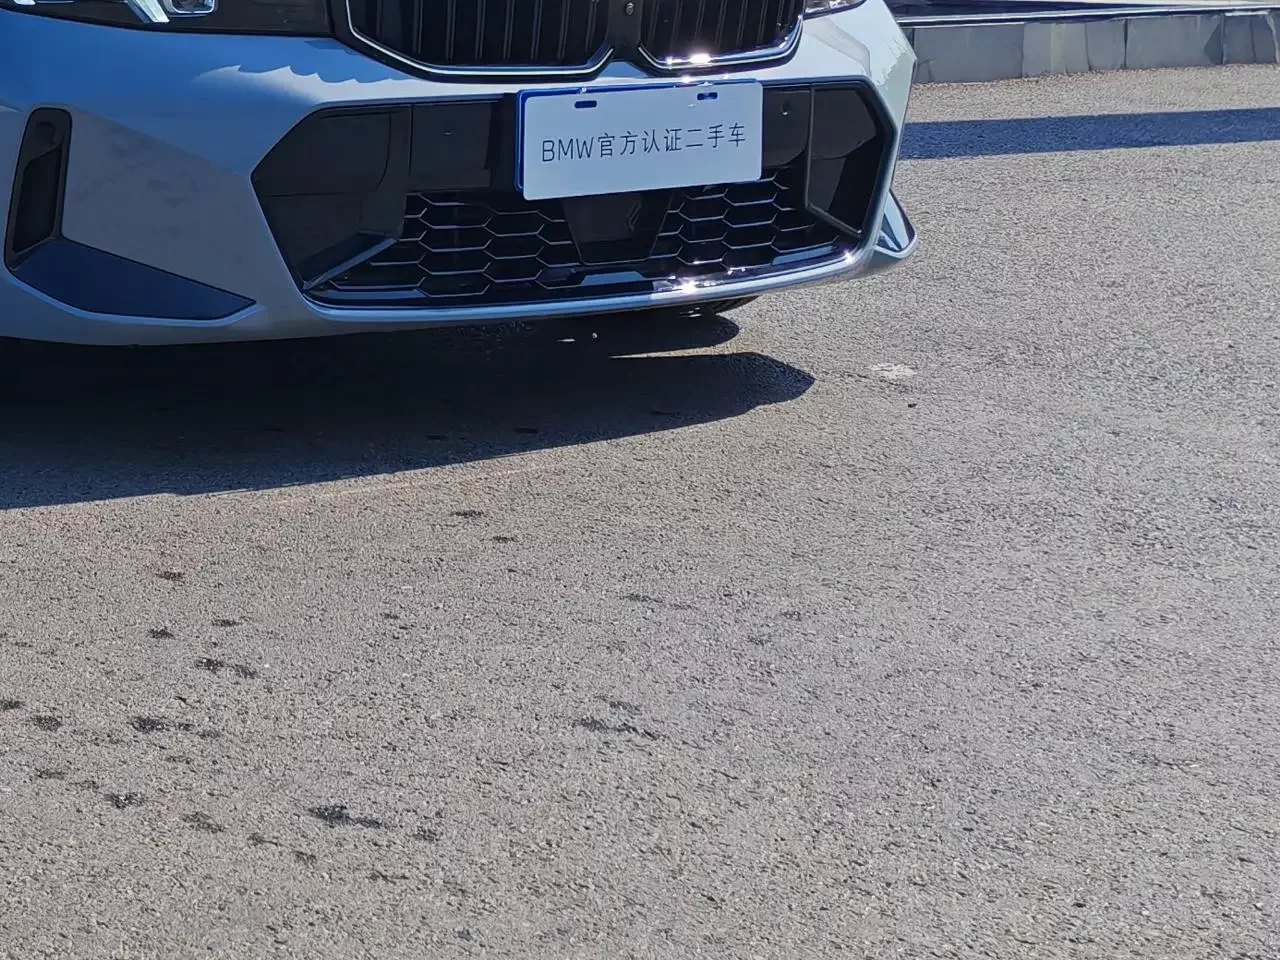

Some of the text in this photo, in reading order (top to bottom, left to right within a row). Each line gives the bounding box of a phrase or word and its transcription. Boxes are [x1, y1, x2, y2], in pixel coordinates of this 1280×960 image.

[542, 122, 746, 162] BMW官方认证二手车
